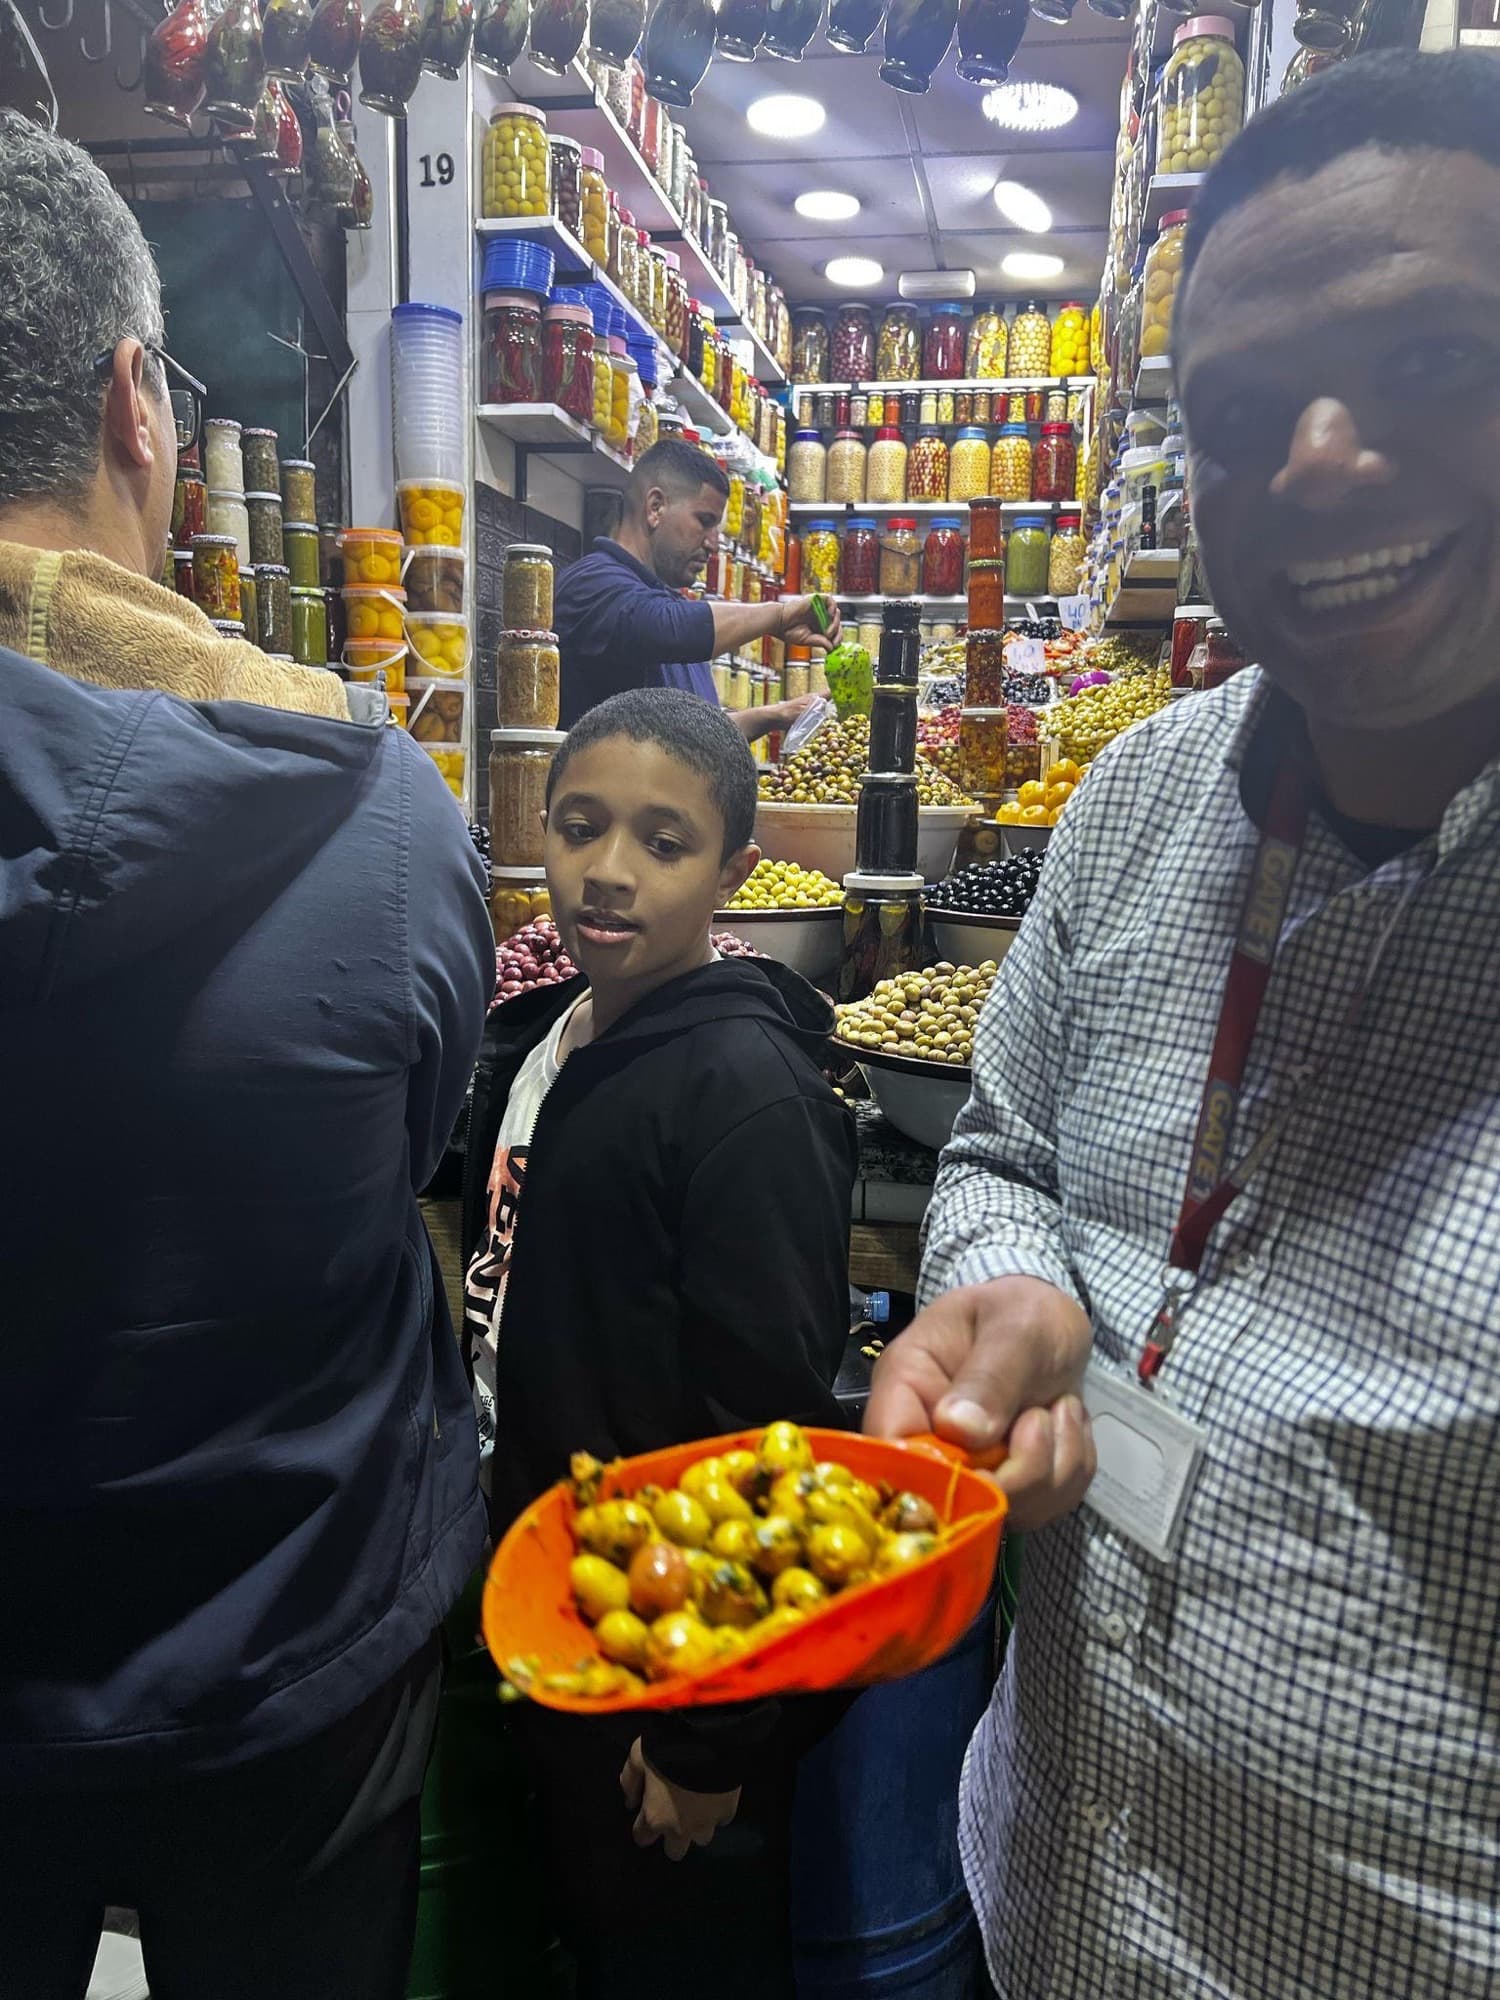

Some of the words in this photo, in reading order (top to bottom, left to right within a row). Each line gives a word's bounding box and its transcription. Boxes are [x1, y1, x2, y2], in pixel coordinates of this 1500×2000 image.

[419, 153, 455, 187] 19
[1067, 603, 1086, 618] 40
[1247, 847, 1292, 935] GATE
[1196, 1090, 1233, 1178] GATE
